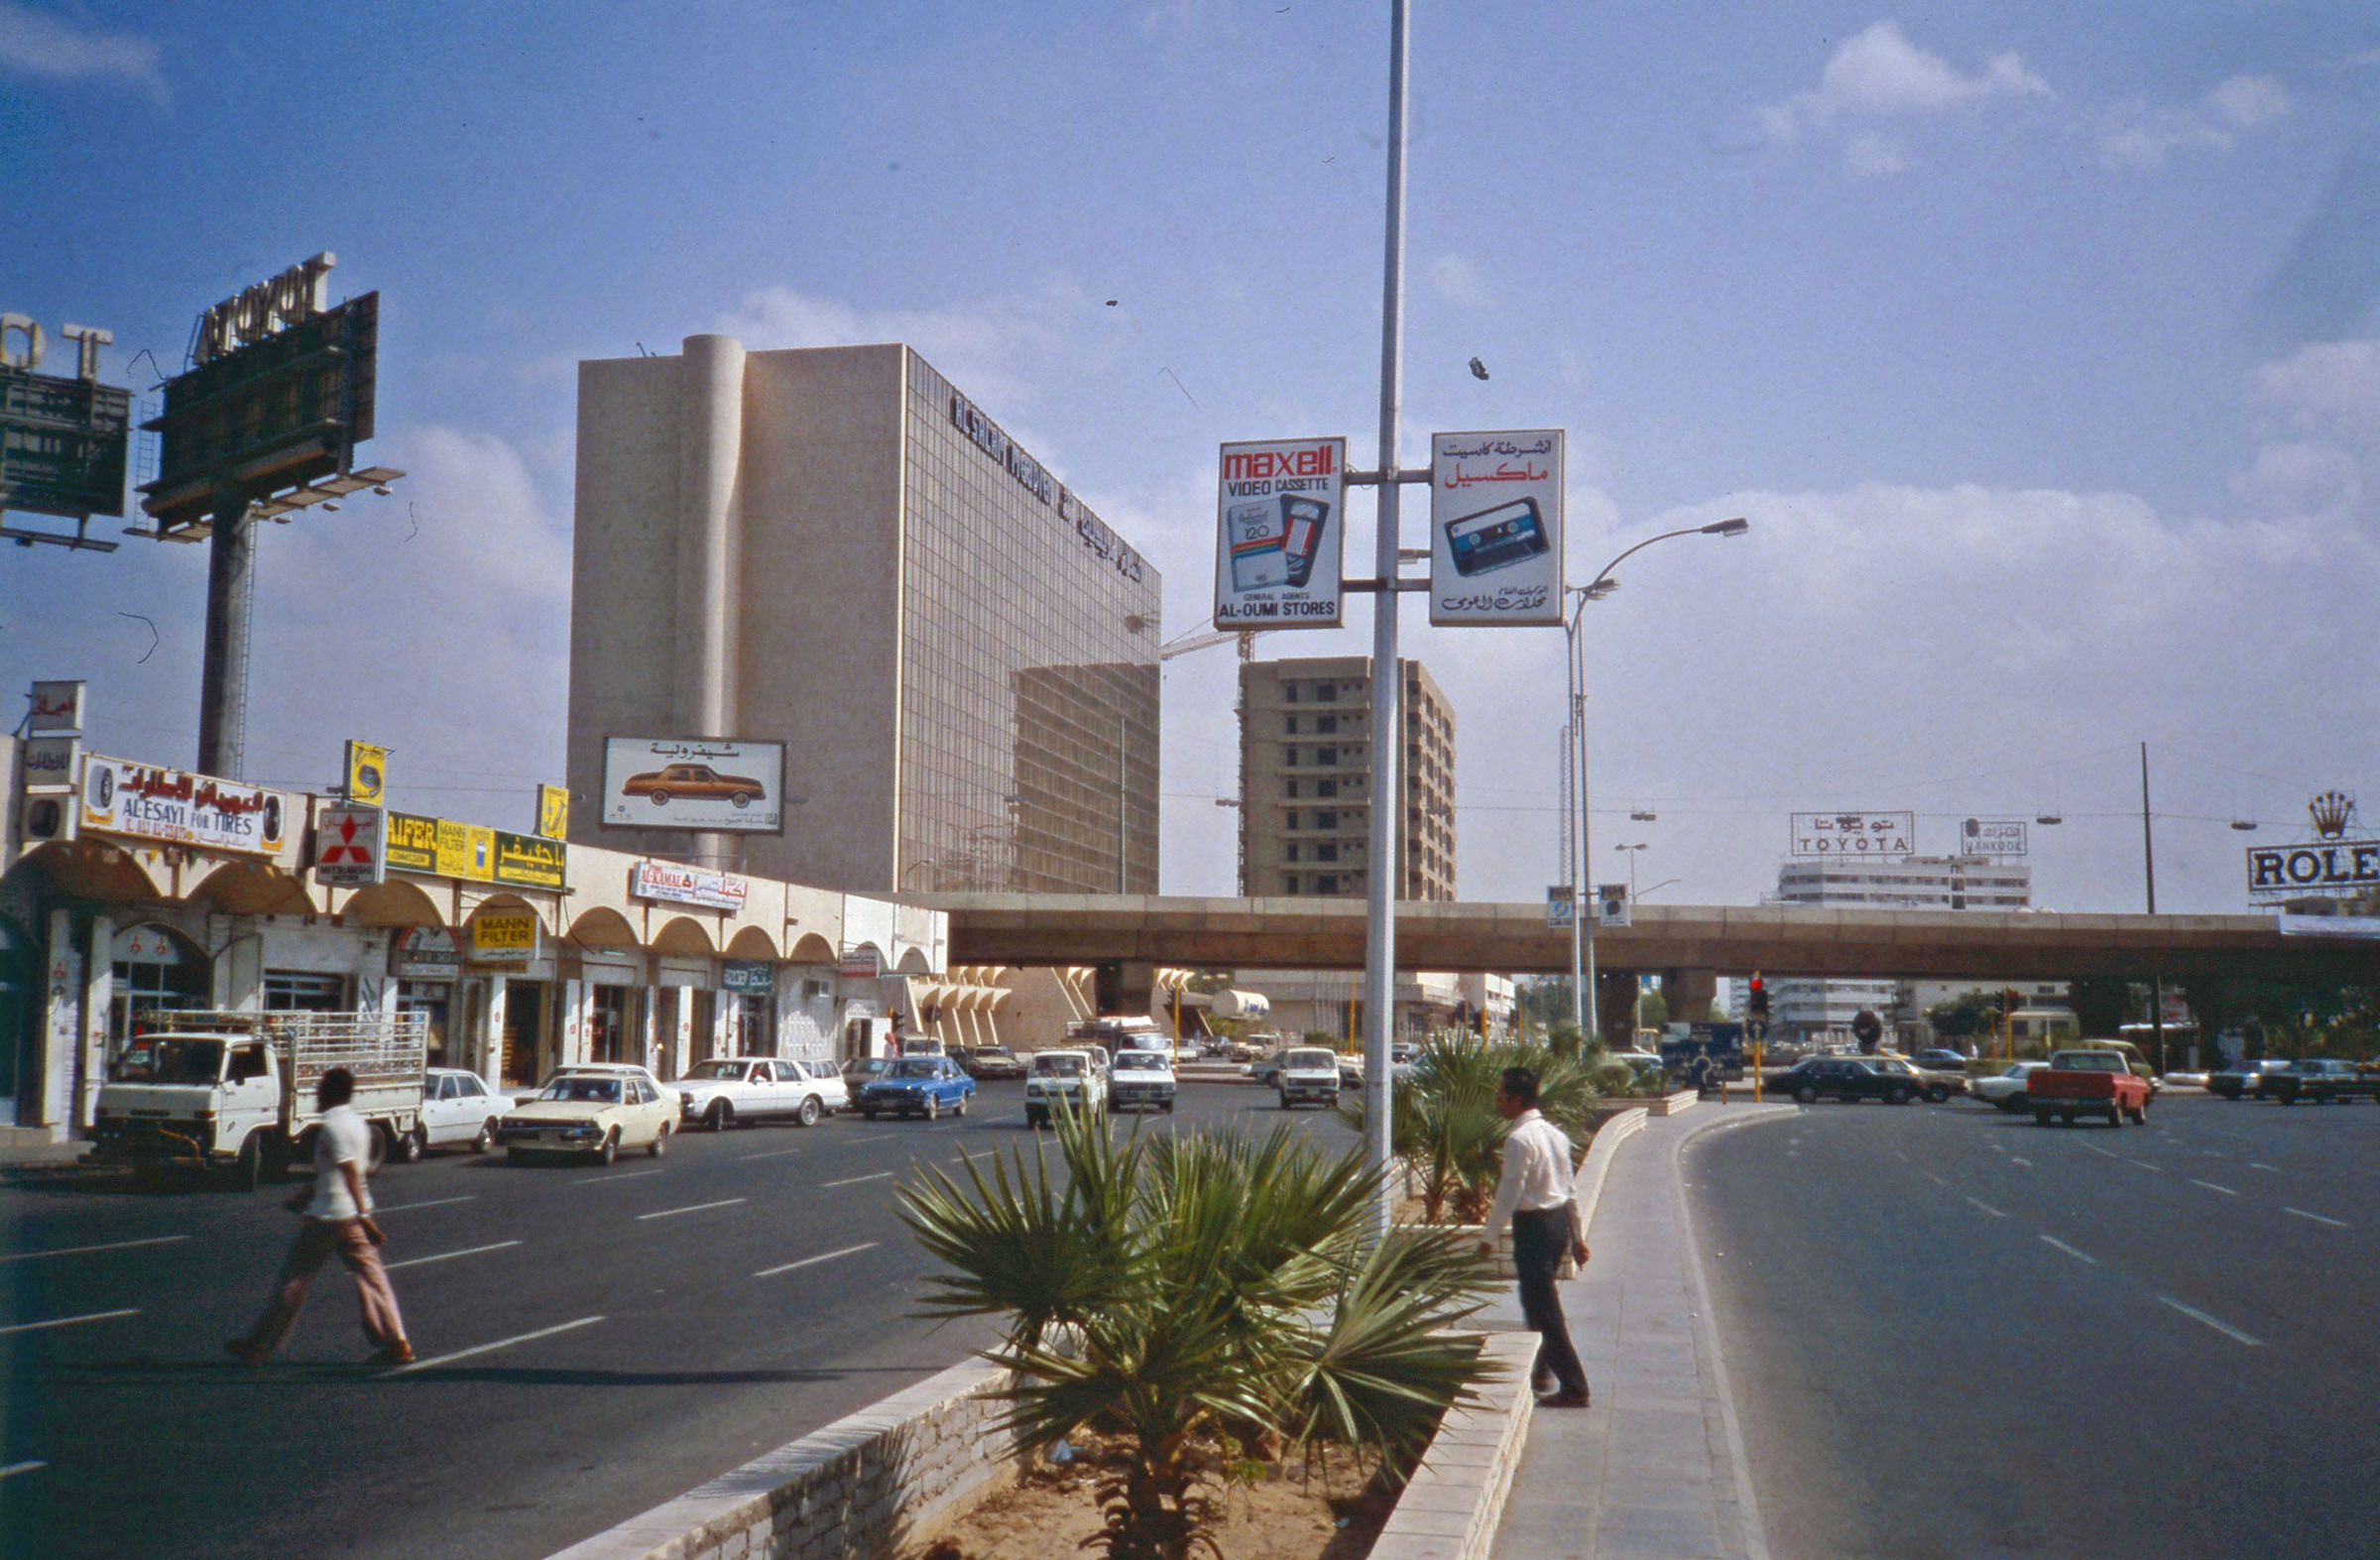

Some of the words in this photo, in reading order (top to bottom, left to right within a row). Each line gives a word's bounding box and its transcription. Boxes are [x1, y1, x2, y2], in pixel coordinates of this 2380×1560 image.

[1224, 444, 1333, 480] maxell
[1445, 460, 1549, 489] ماكسيل
[1229, 480, 1271, 497] VIDEO
[1275, 477, 1329, 492] CASSETTE
[1244, 592, 1275, 601] GENERAL
[1281, 591, 1310, 600] AGENTS
[1219, 601, 1278, 617] AL-OUMI
[1283, 601, 1335, 616] STORES
[123, 798, 185, 825] AL-ESAYI
[191, 812, 209, 829] FOR
[214, 811, 253, 836] TIRES
[1800, 838, 1908, 851] TOYOTA
[481, 917, 531, 930] MANN
[480, 930, 531, 943] FILTER
